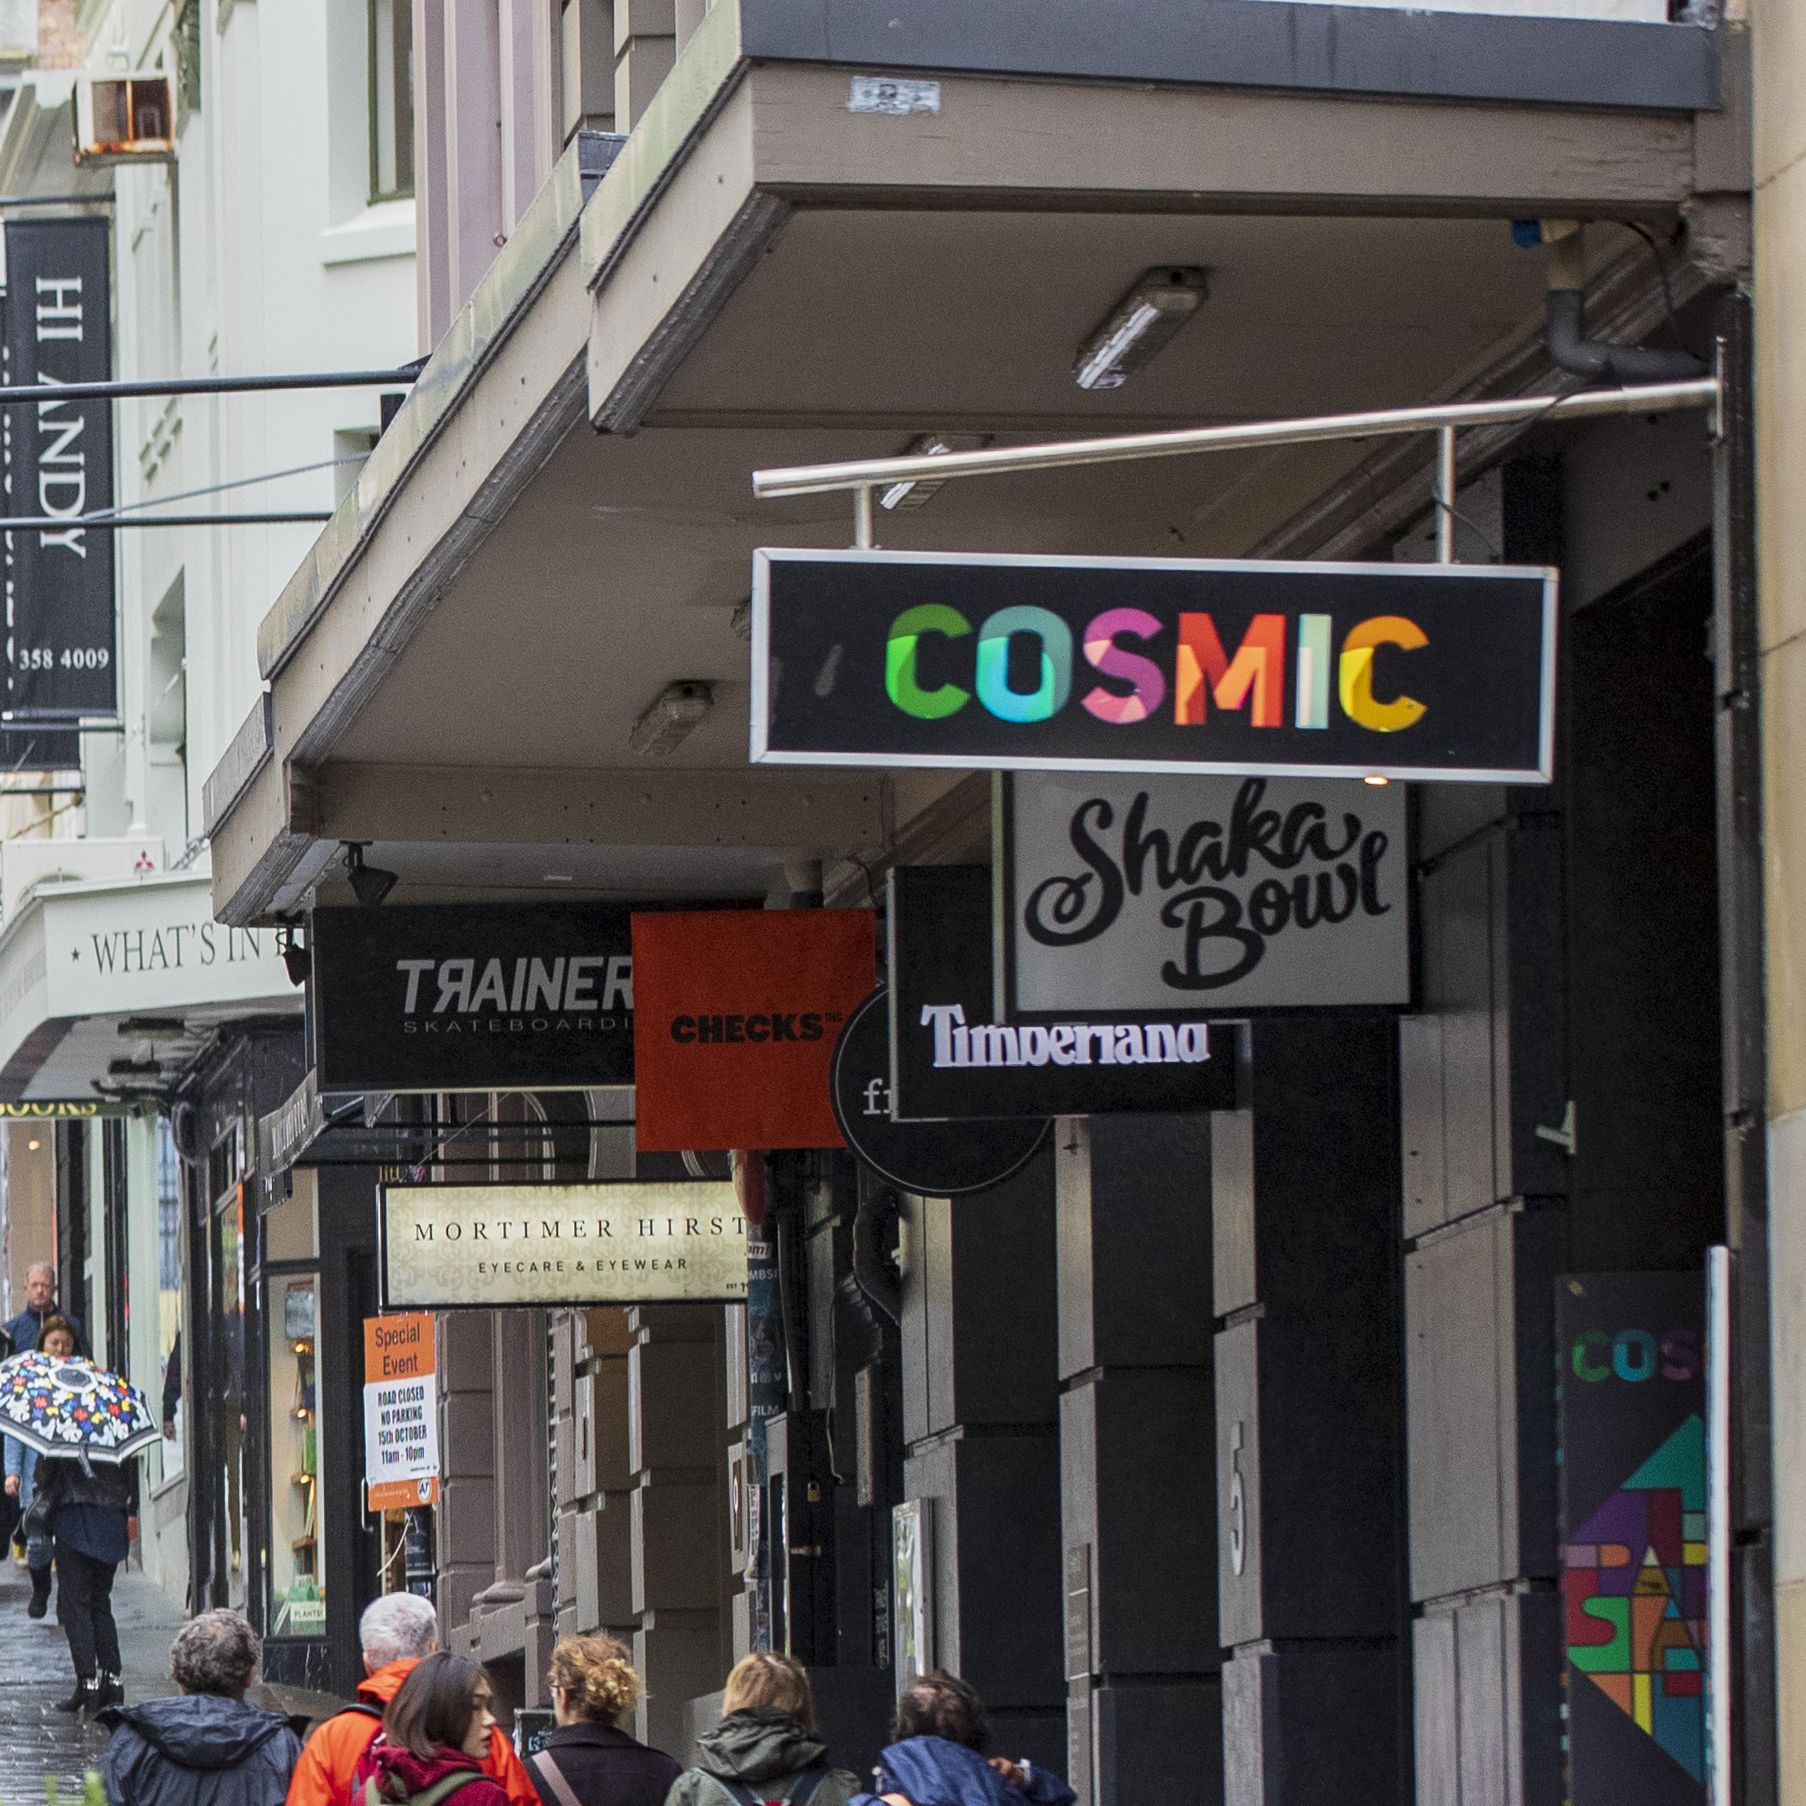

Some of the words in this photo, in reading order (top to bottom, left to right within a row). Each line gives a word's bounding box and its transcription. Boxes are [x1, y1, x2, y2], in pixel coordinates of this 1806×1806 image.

[19, 647, 53, 670] 358
[60, 647, 110, 670] 4009
[885, 603, 1430, 733] COSMIC
[1024, 778, 1363, 948] Shaka
[1160, 830, 1391, 991] Bowl
[91, 922, 216, 975] WHAT'S
[670, 1012, 825, 1045] CHECKS
[414, 1220, 614, 1242] MORTIMER
[638, 1216, 747, 1237] HIRST
[479, 1261, 565, 1273] EYECARE
[576, 1260, 585, 1272] &
[596, 1257, 687, 1271] EYEWEAR
[375, 1322, 420, 1351] Special
[383, 1353, 418, 1376] Event
[378, 1390, 396, 1406] ROAD
[398, 1385, 425, 1403] CLOSED
[381, 1409, 391, 1426] NO
[392, 1405, 423, 1425] PARKING
[379, 1429, 393, 1446] 15th
[395, 1424, 428, 1444] OCTOBER
[405, 1445, 425, 1465] 10pm
